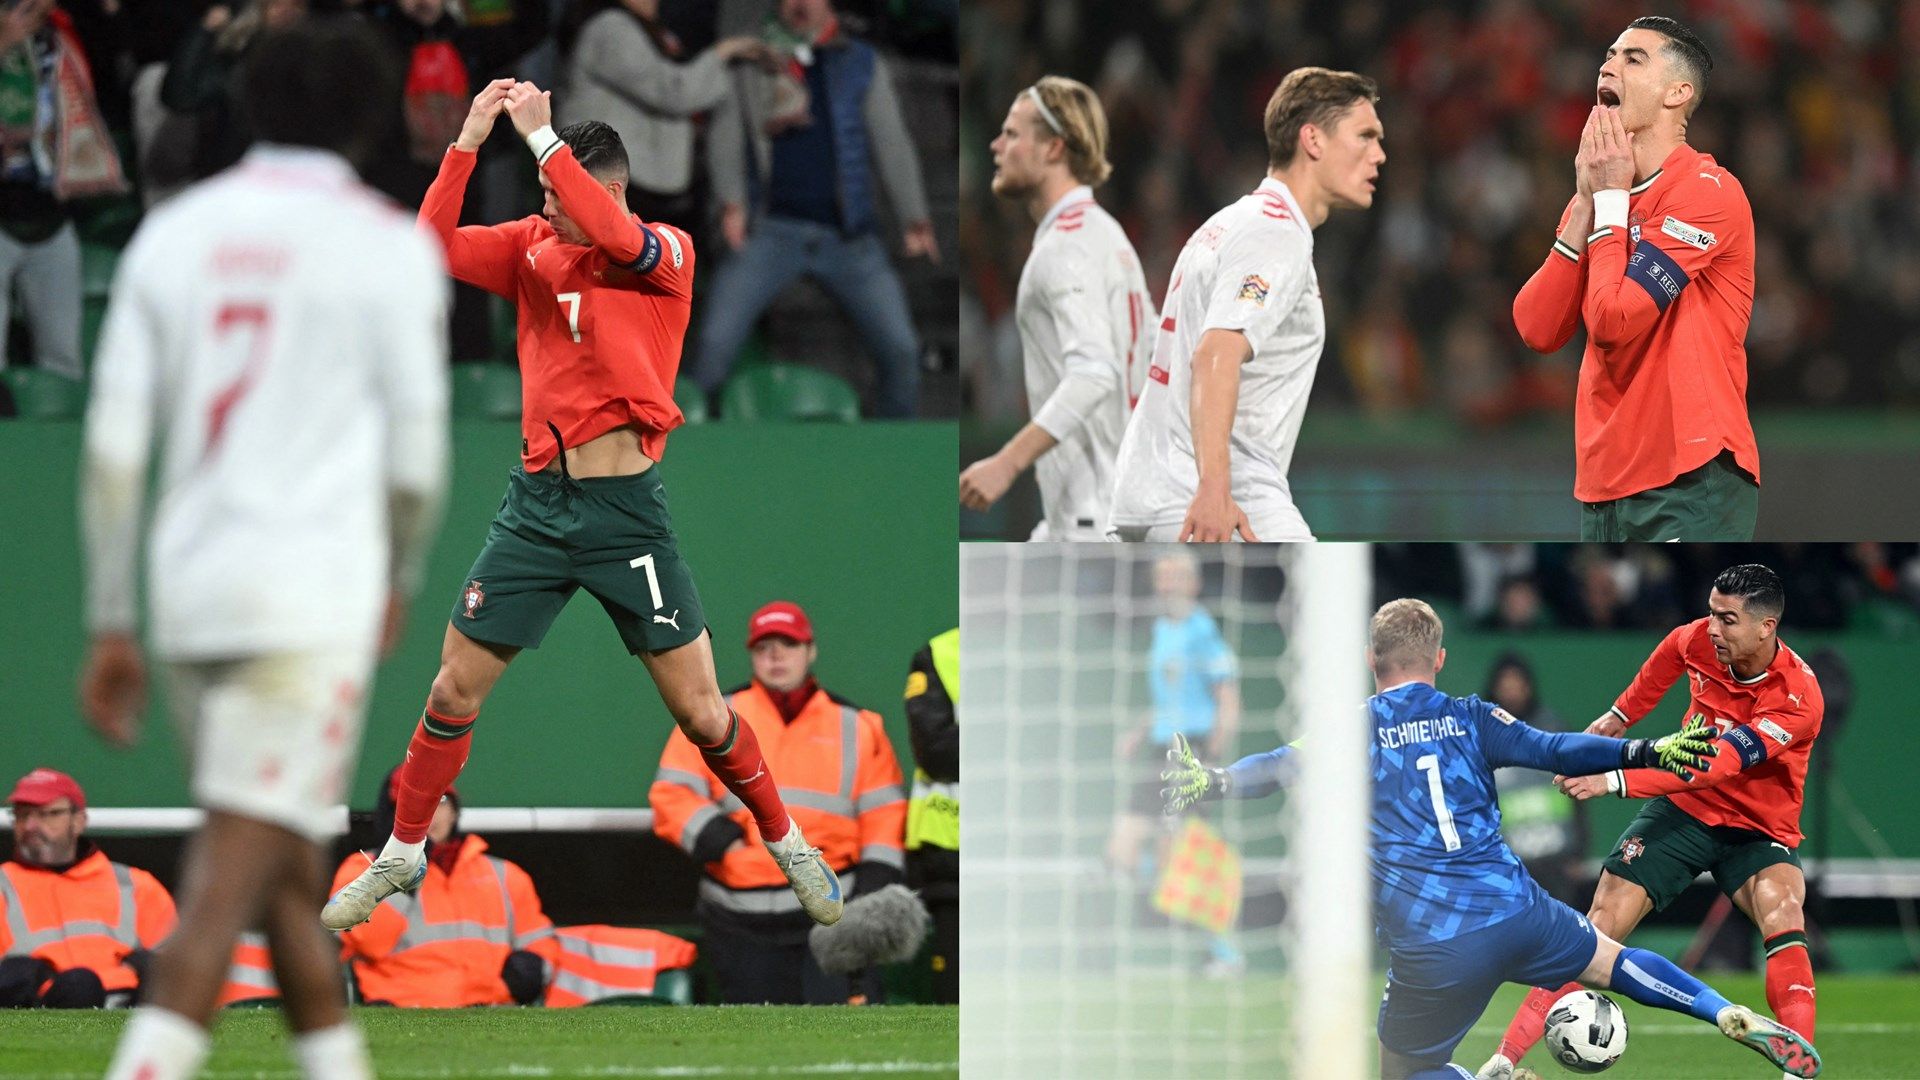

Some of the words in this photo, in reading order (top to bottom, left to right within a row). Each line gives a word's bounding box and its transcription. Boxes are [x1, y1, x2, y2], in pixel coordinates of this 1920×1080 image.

[556, 291, 582, 343] 7
[204, 302, 272, 456] 7
[629, 553, 664, 611] 7
[1416, 753, 1462, 853] 1
